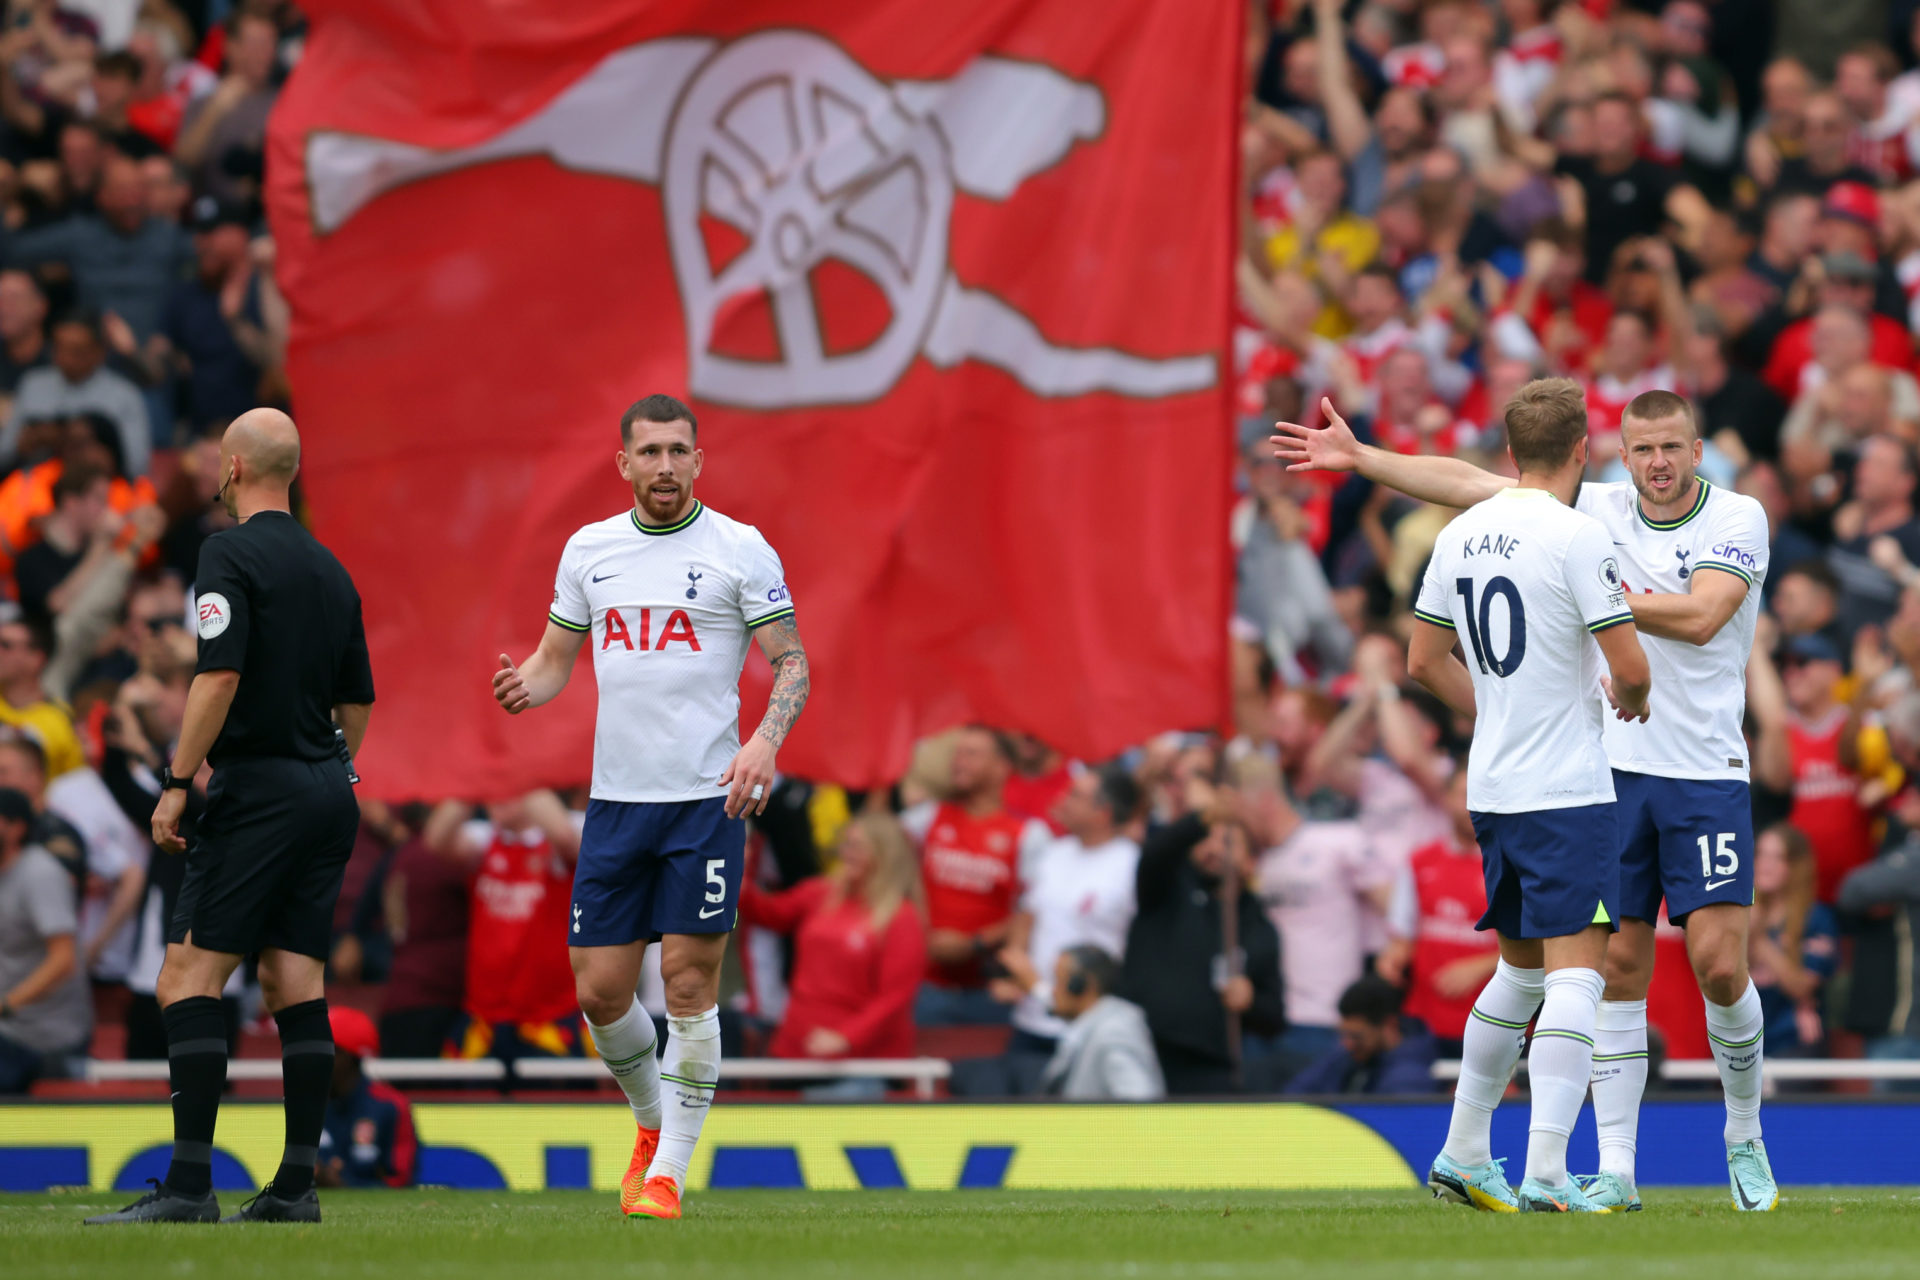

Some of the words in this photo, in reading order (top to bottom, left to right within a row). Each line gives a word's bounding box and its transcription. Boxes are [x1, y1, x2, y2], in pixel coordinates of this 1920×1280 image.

[1464, 533, 1520, 560] KANE
[1711, 540, 1756, 570] cinch
[767, 580, 790, 602] cin
[199, 603, 223, 621] EA
[200, 616, 224, 630] SPORTS
[601, 608, 702, 651] AIA
[1456, 575, 1527, 679] 10
[1696, 832, 1739, 878] 15
[704, 859, 726, 903] 5
[1591, 1067, 1621, 1076] URS
